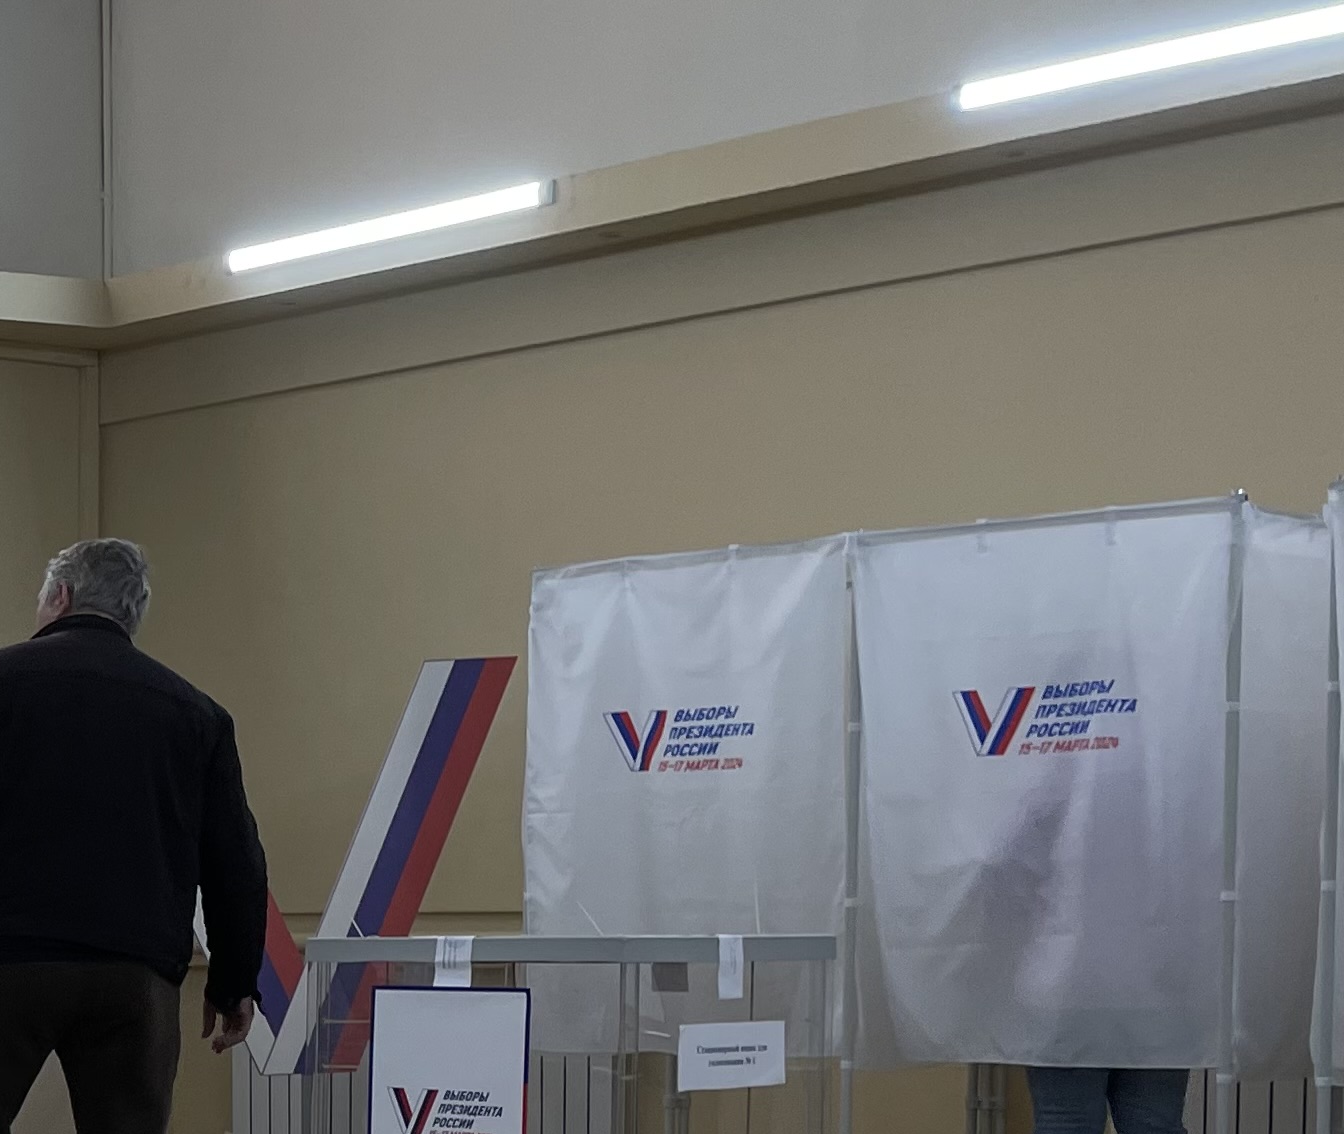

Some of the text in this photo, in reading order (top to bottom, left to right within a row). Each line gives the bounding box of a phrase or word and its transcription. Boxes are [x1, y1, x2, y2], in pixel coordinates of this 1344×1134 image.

[1041, 679, 1115, 700] ВЫБОРЫ
[674, 705, 739, 722] ВЫБОРЫ
[1034, 698, 1138, 719] ПРЕЗИДЕНТА
[669, 722, 755, 740] ПРЕЗИДЕНТА
[1026, 720, 1090, 738] РОССИИ
[663, 742, 721, 758] РОССИИ
[1053, 738, 1090, 753] МАРТА
[684, 758, 720, 772] МАРТА
[443, 1090, 490, 1102] ВЫБОРЫ
[437, 1103, 503, 1118] ПРЕЗИДЕНТА
[432, 1117, 474, 1130] РОССИИ
